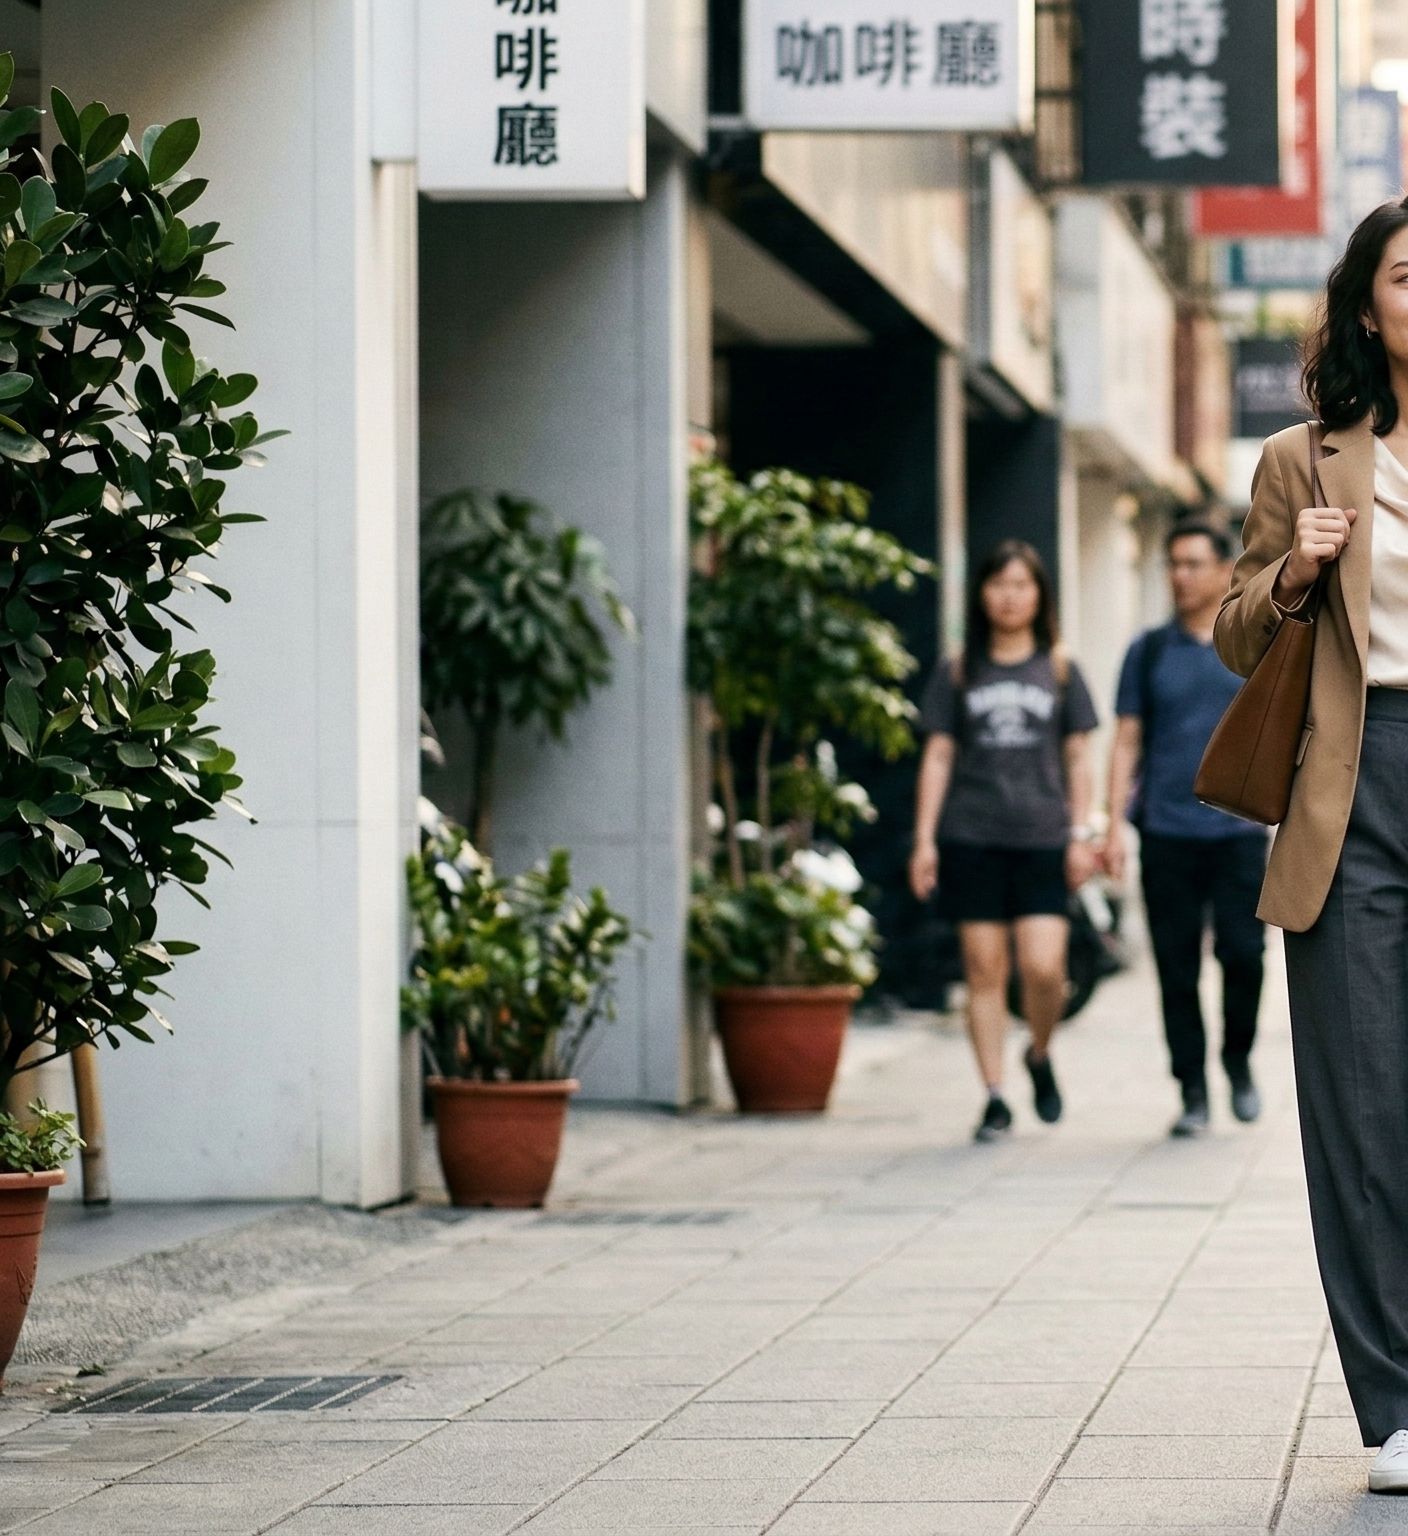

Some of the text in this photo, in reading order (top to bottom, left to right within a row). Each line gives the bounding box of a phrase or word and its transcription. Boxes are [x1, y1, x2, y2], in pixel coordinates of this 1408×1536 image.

[494, 0, 558, 167] 啡廳
[776, 18, 1001, 87] 咖啡廳
